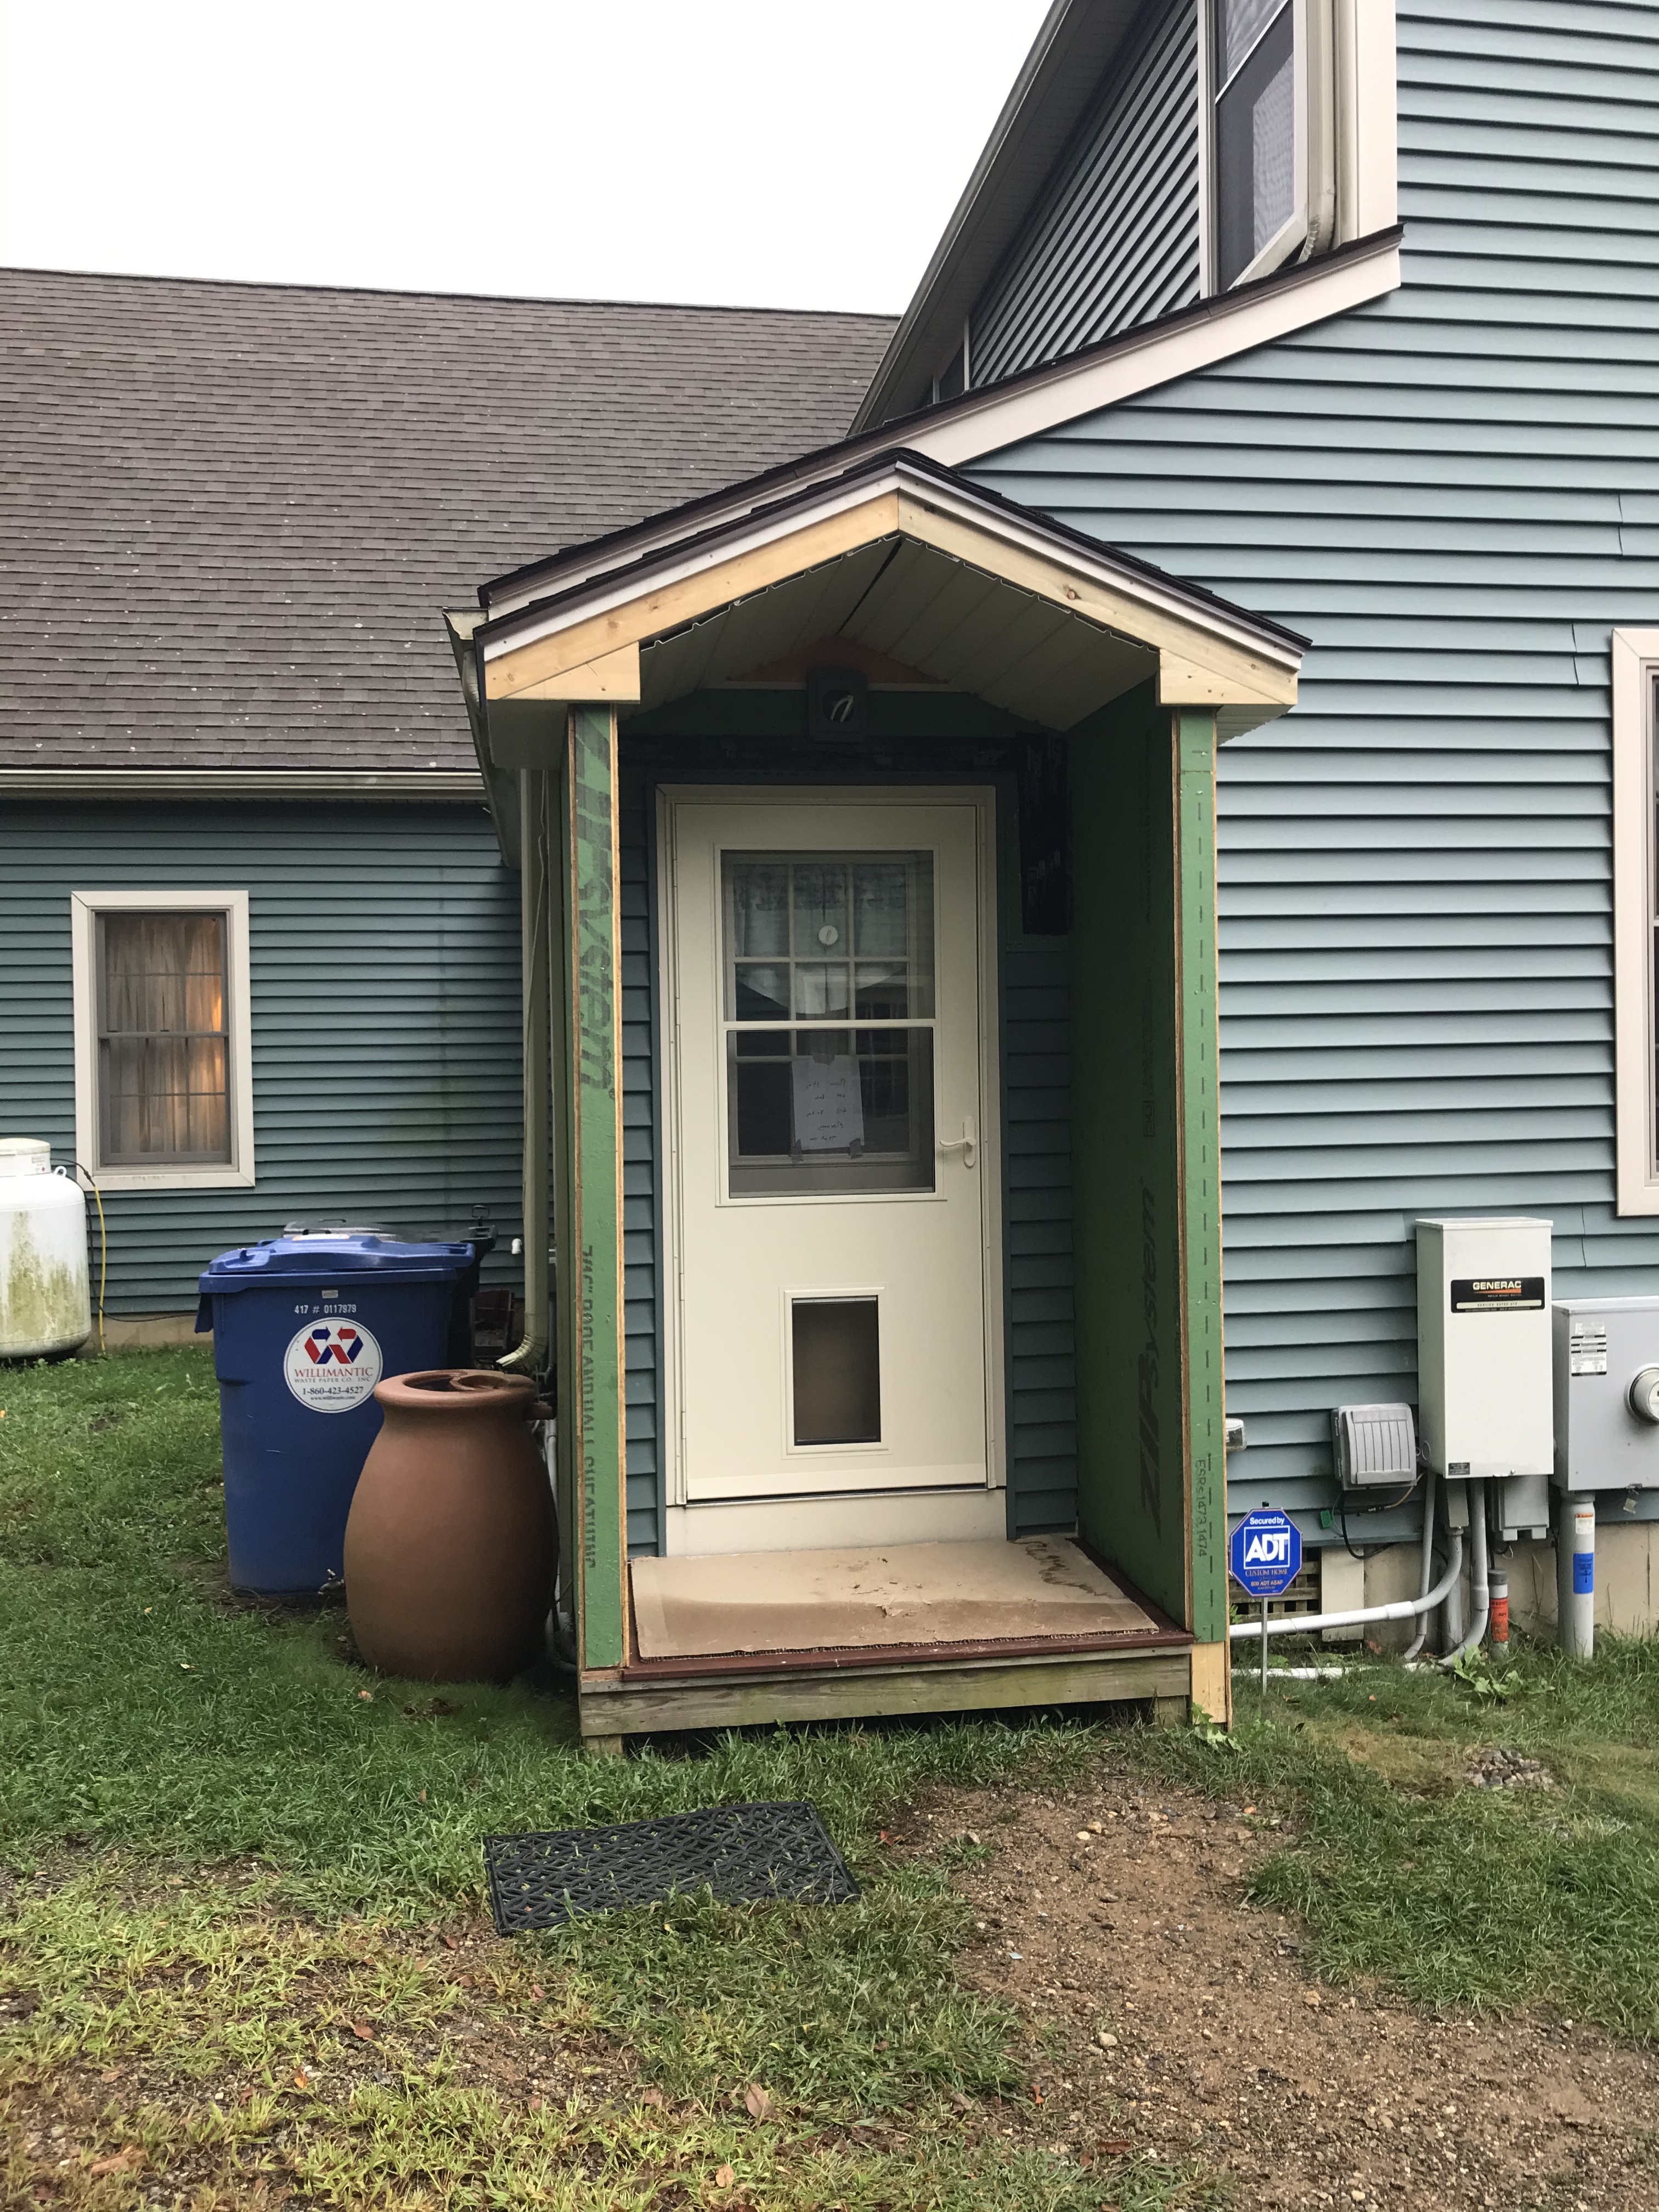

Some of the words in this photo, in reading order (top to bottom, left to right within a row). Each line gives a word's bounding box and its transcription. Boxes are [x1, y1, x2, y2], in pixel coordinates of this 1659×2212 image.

[1472, 1280, 1522, 1290] GENERAC
[294, 1305, 309, 1314] 417
[324, 1304, 357, 1313] 0117979
[294, 1367, 374, 1378] WILLIMANTIC
[302, 1386, 364, 1395] 1-860-423-4527
[1250, 1516, 1277, 1525] Secured
[1277, 1516, 1285, 1525] by
[1245, 1533, 1289, 1562] ADT
